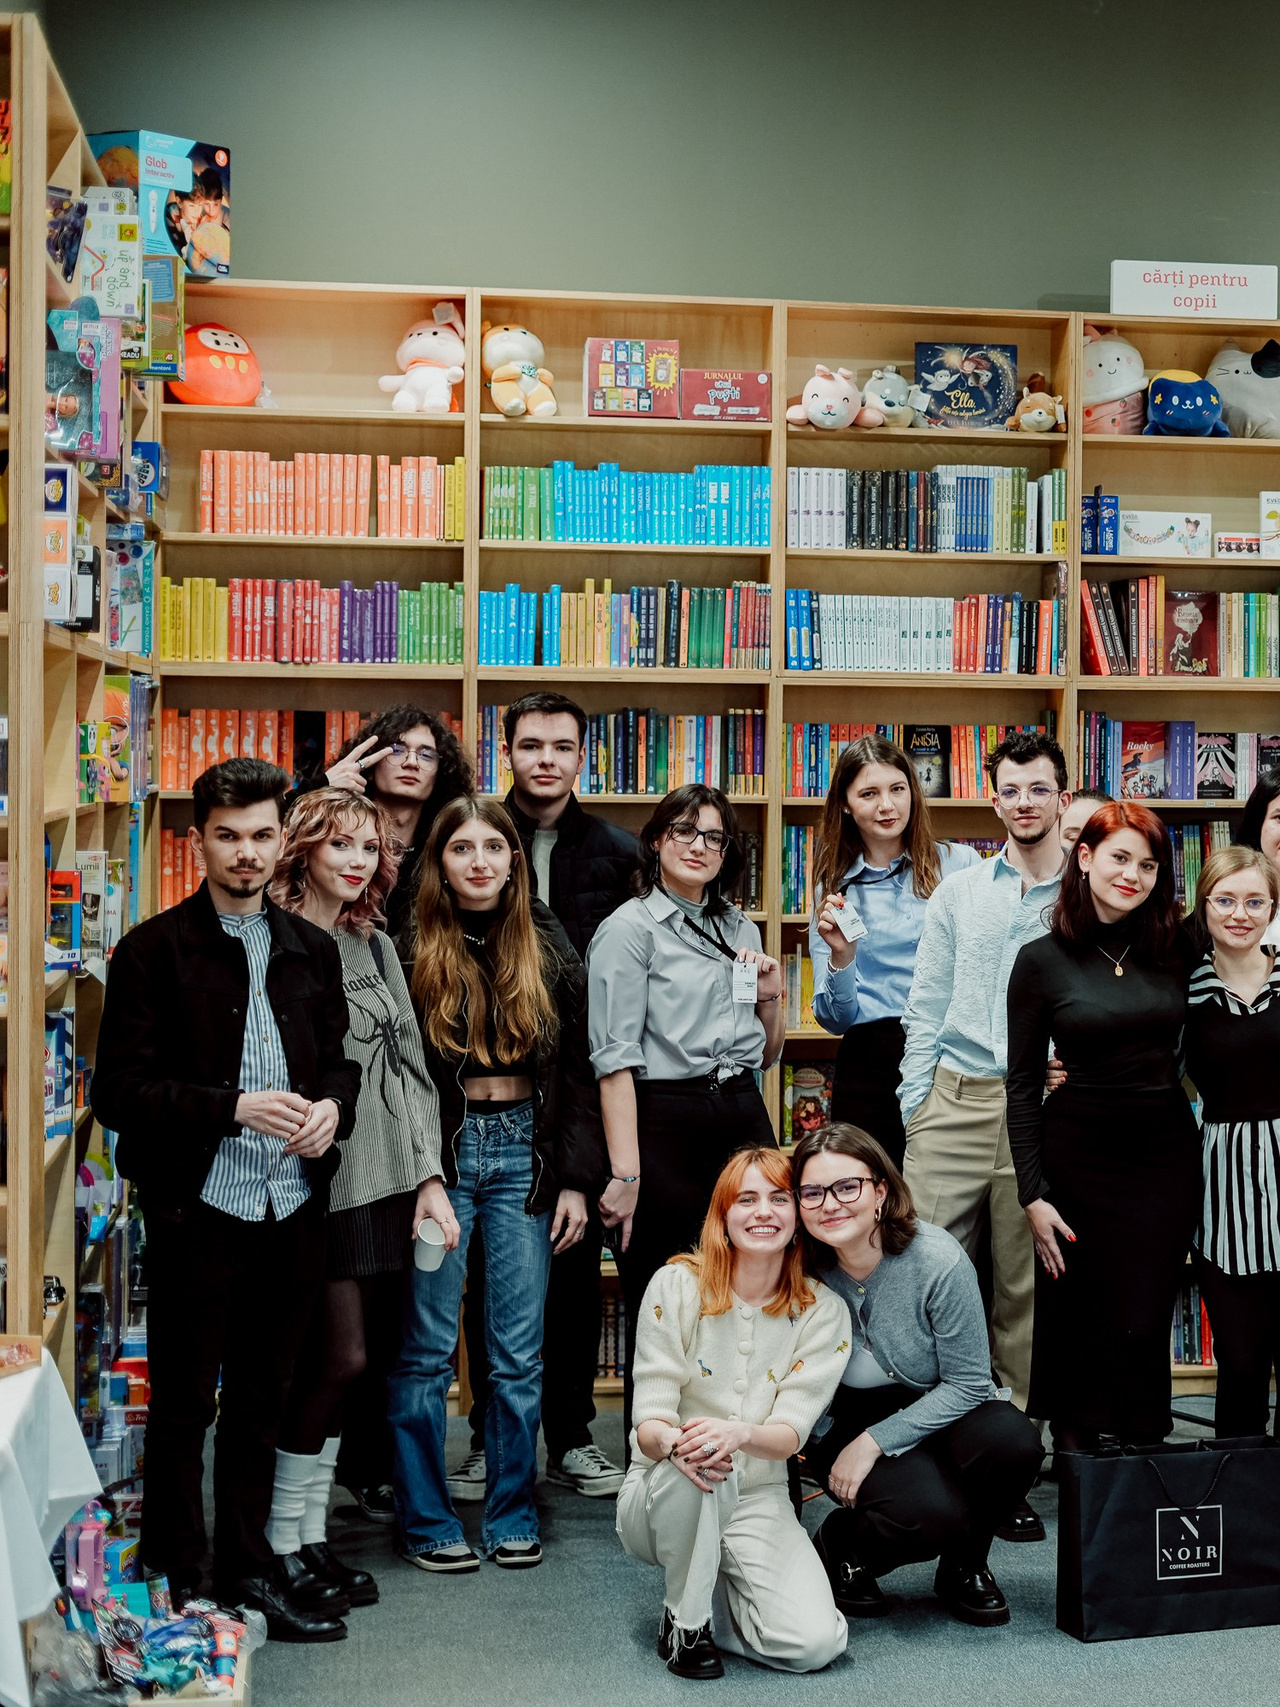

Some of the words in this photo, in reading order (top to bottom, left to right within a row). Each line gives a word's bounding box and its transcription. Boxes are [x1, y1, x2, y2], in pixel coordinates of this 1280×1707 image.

[145, 155, 168, 173] Glob
[145, 168, 175, 179] Interactiv
[117, 250, 132, 263] up
[119, 268, 132, 288] and
[1142, 269, 1185, 288] cărți
[1188, 272, 1248, 289] pentru
[106, 277, 119, 308] down
[1173, 294, 1218, 312] copii
[703, 372, 744, 382] JURNALUL
[714, 380, 732, 389] unui
[1098, 609, 1108, 635] ROMÂNILOR
[1107, 609, 1118, 635] ROMÂNILOR
[1104, 635, 1114, 658] BASMELE
[1113, 635, 1124, 658] BASMELE
[1126, 741, 1154, 751] Rocky
[76, 862, 100, 870] Lumii
[1180, 1515, 1200, 1540] N
[1161, 1545, 1218, 1562] NOIR
[1169, 1562, 1187, 1570] COFFEE
[1187, 1561, 1211, 1569] ROASTERS
